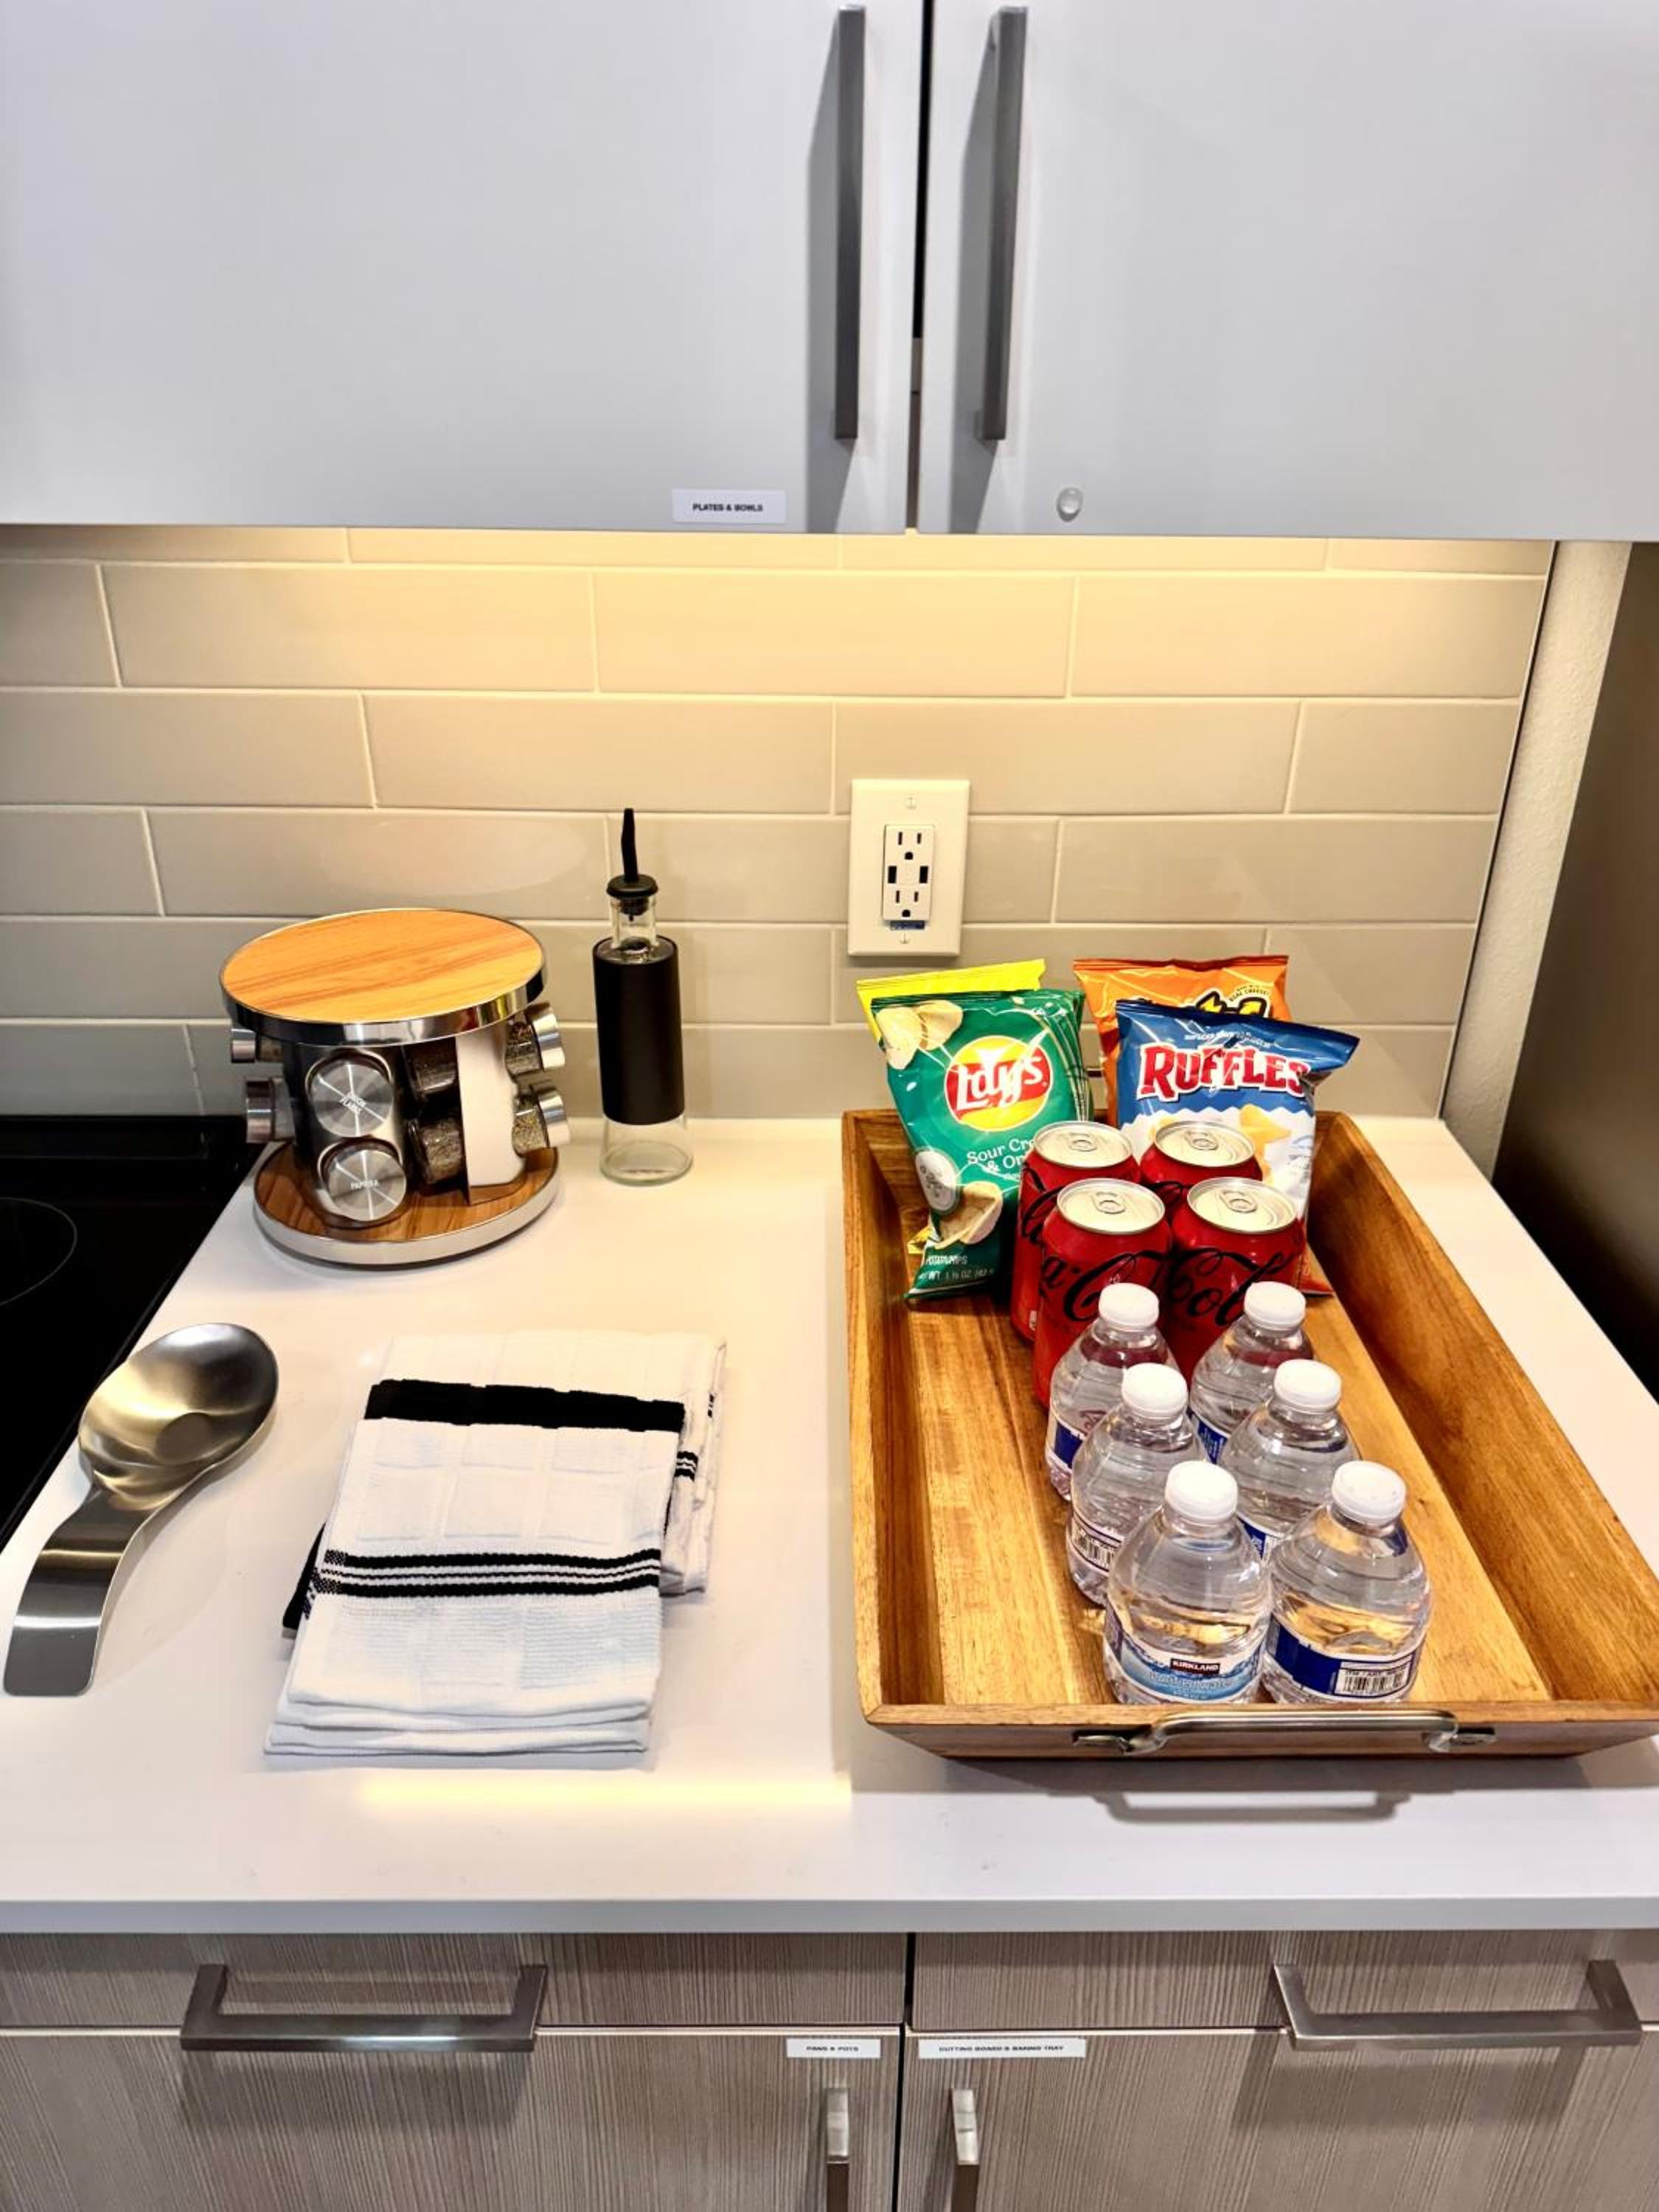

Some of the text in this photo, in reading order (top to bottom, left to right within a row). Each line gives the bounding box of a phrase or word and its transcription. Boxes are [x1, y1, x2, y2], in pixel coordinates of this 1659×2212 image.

[692, 504, 724, 512] PLATES
[726, 504, 732, 512] &
[1138, 1043, 1311, 1101] RUFFLES
[967, 1145, 1006, 1164] Sour
[1008, 1138, 1035, 1152] Cre
[1172, 1660, 1219, 1671] KIRKLAND
